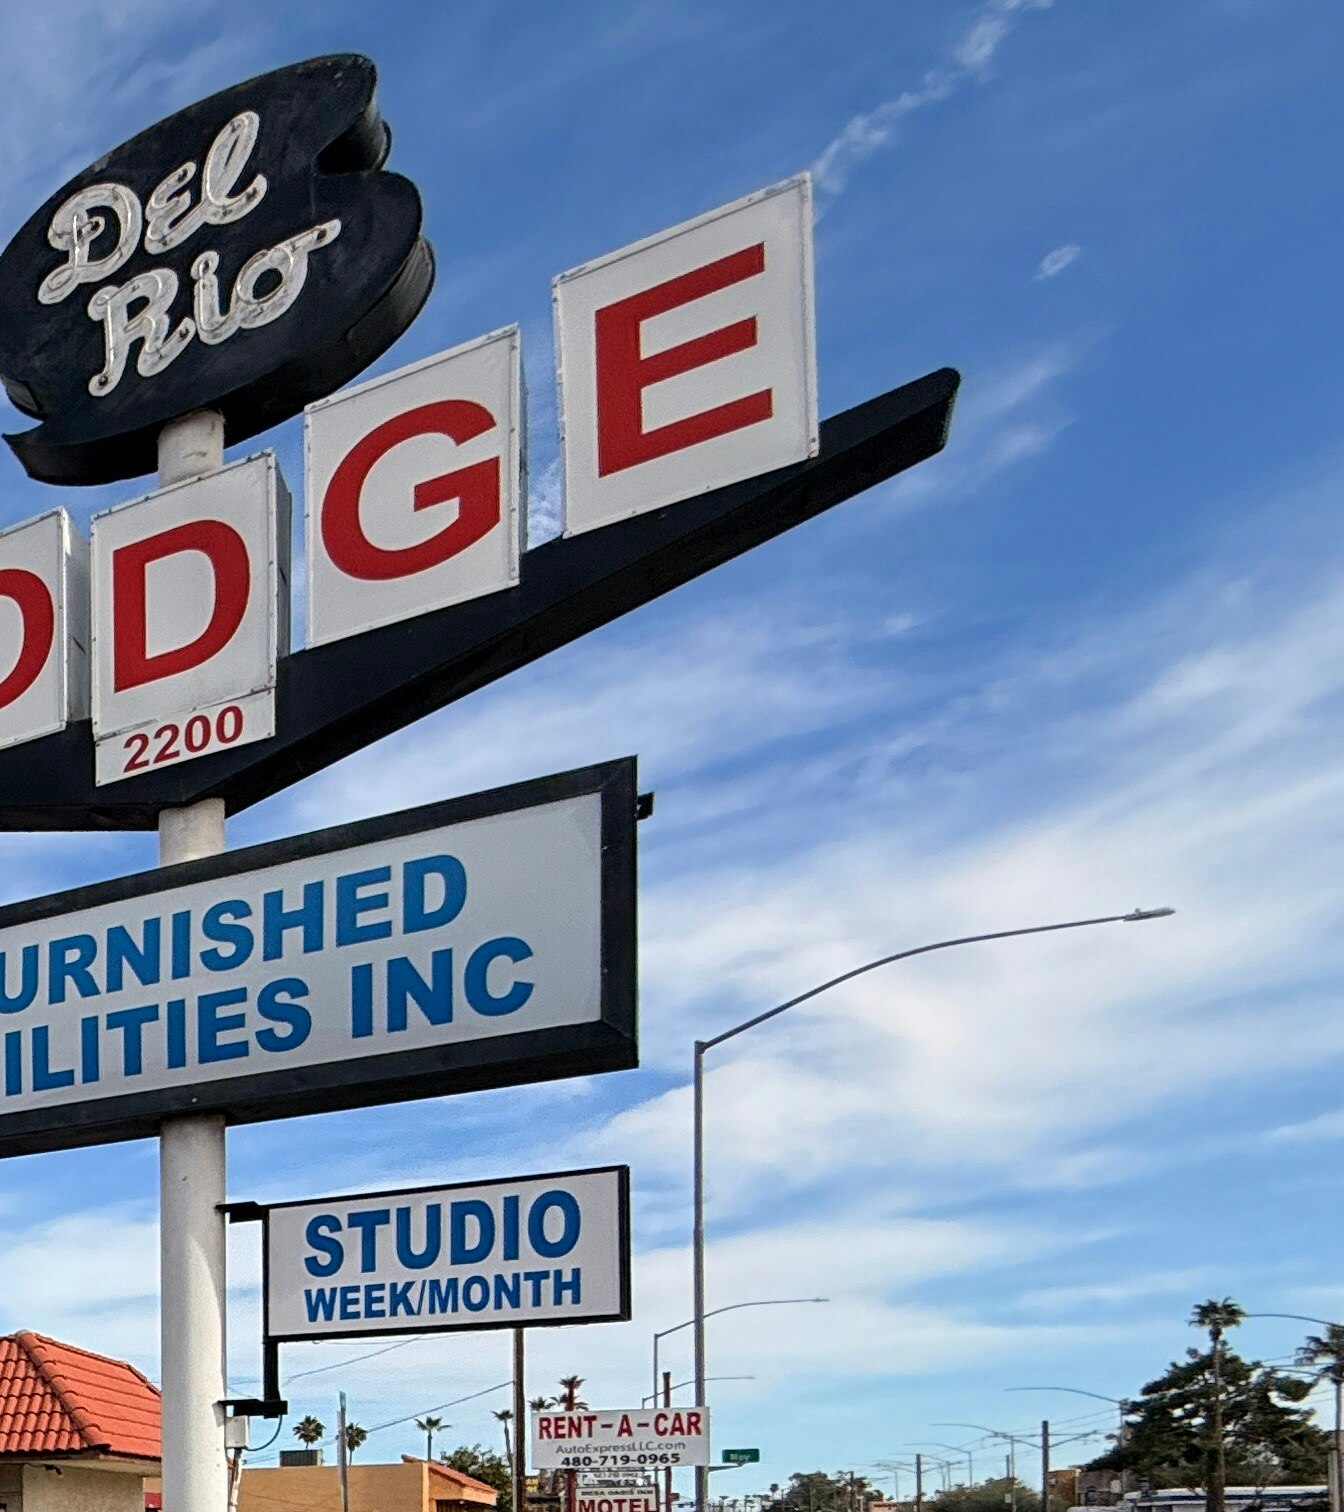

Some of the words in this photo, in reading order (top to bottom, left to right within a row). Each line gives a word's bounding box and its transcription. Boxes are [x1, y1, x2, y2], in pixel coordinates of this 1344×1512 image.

[88, 218, 341, 398] Rio
[122, 705, 245, 771] 2200
[350, 936, 535, 1039] INC
[304, 1189, 582, 1278] STUDIO
[304, 1267, 582, 1323] WEEK/MONTH
[555, 1440, 686, 1455] AutoExpressLLC.com
[561, 1453, 681, 1467] 480-719-0965
